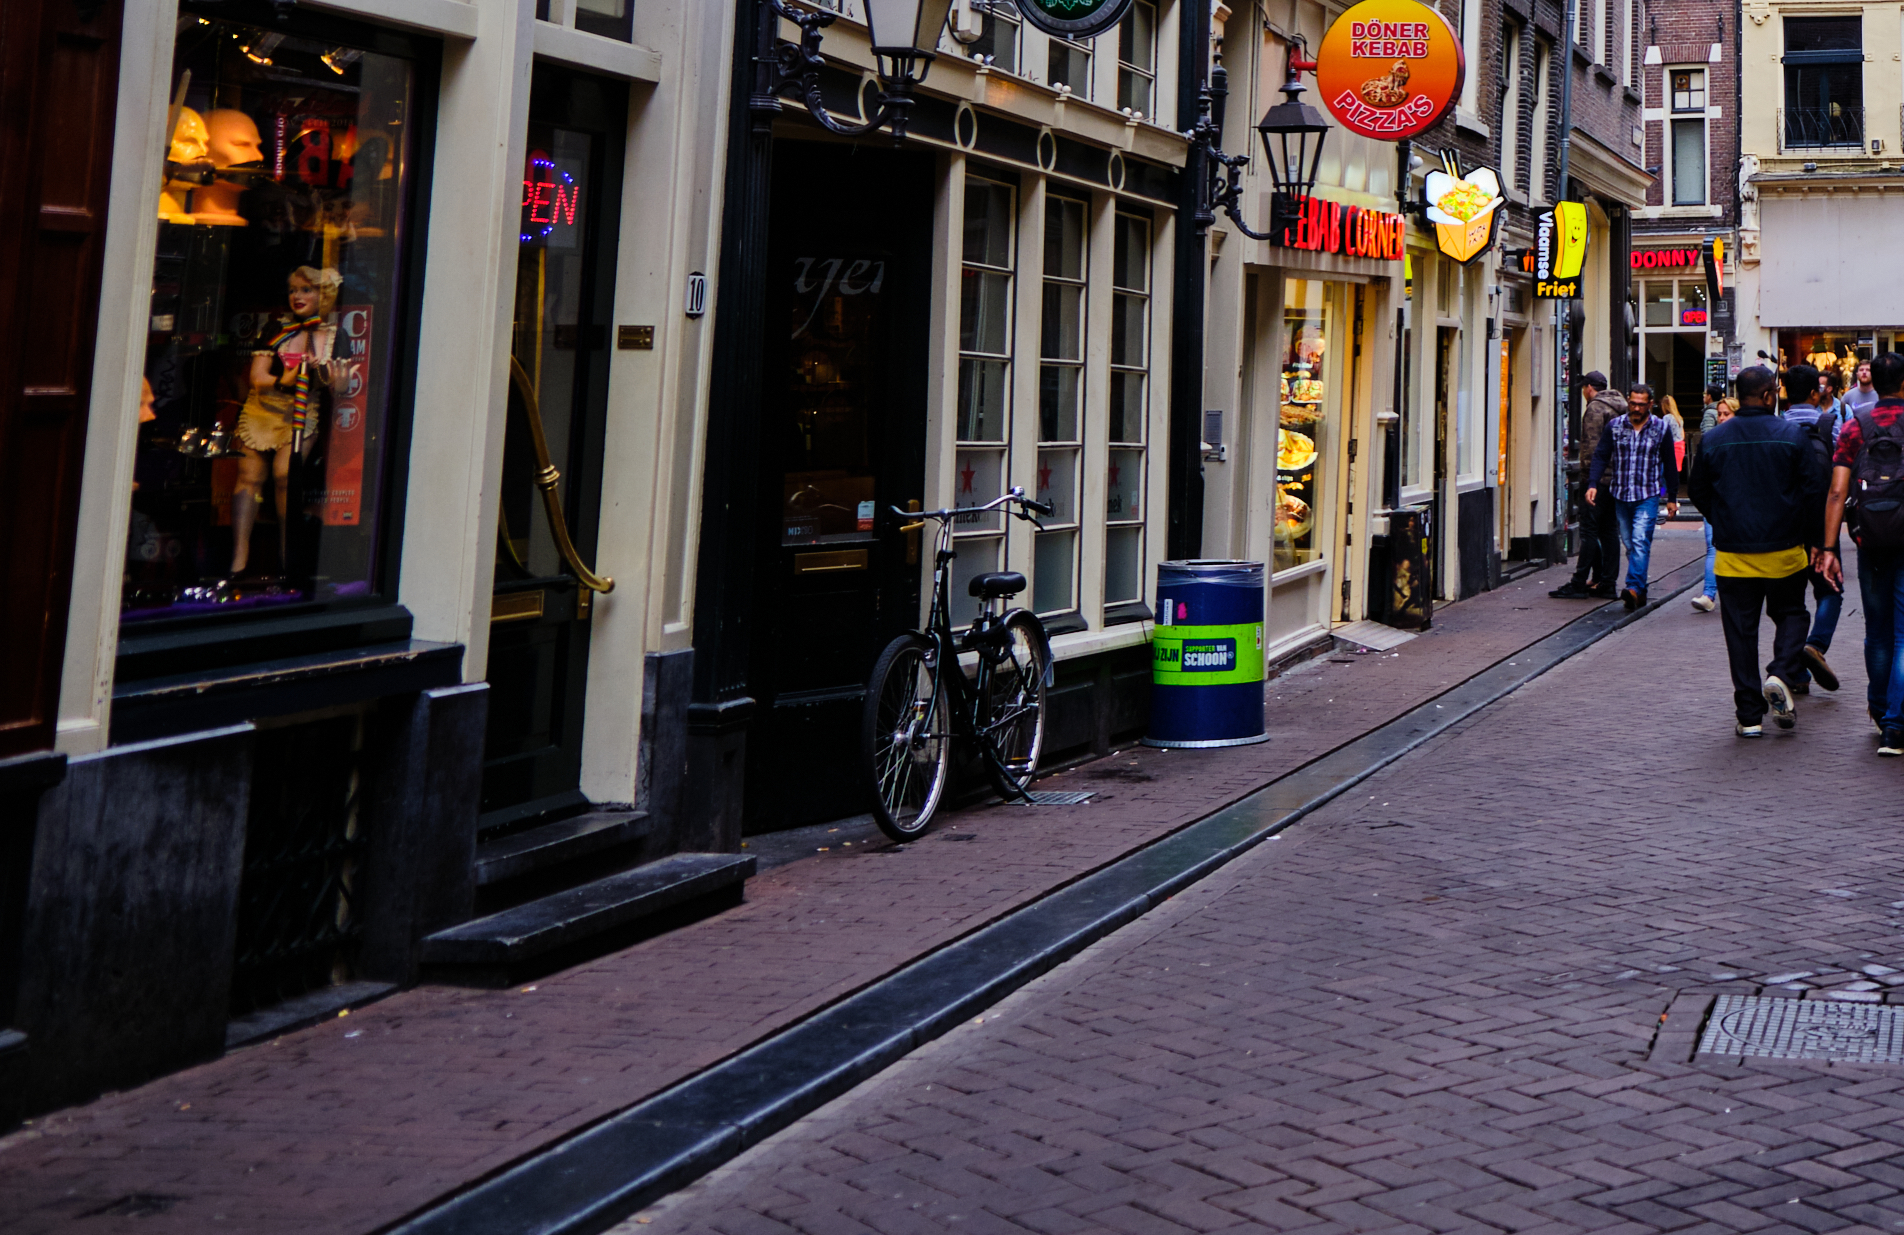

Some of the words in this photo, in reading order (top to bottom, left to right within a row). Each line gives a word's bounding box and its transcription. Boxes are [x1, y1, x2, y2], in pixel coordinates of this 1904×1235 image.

[1350, 19, 1429, 40] DÖNER
[1350, 40, 1428, 58] KEBAB
[1333, 89, 1435, 132] PIZZA'S
[522, 181, 580, 225] PEN
[1285, 193, 1341, 254] EBAB
[1345, 204, 1406, 261] CORNER
[1538, 211, 1554, 280] Vlaamse
[1630, 249, 1698, 269] DONNY
[688, 277, 705, 312] 10
[1537, 281, 1577, 298] Friet
[1161, 648, 1179, 662] ZIJN
[1216, 644, 1227, 652] VAN
[1184, 652, 1228, 667] SCHOON
